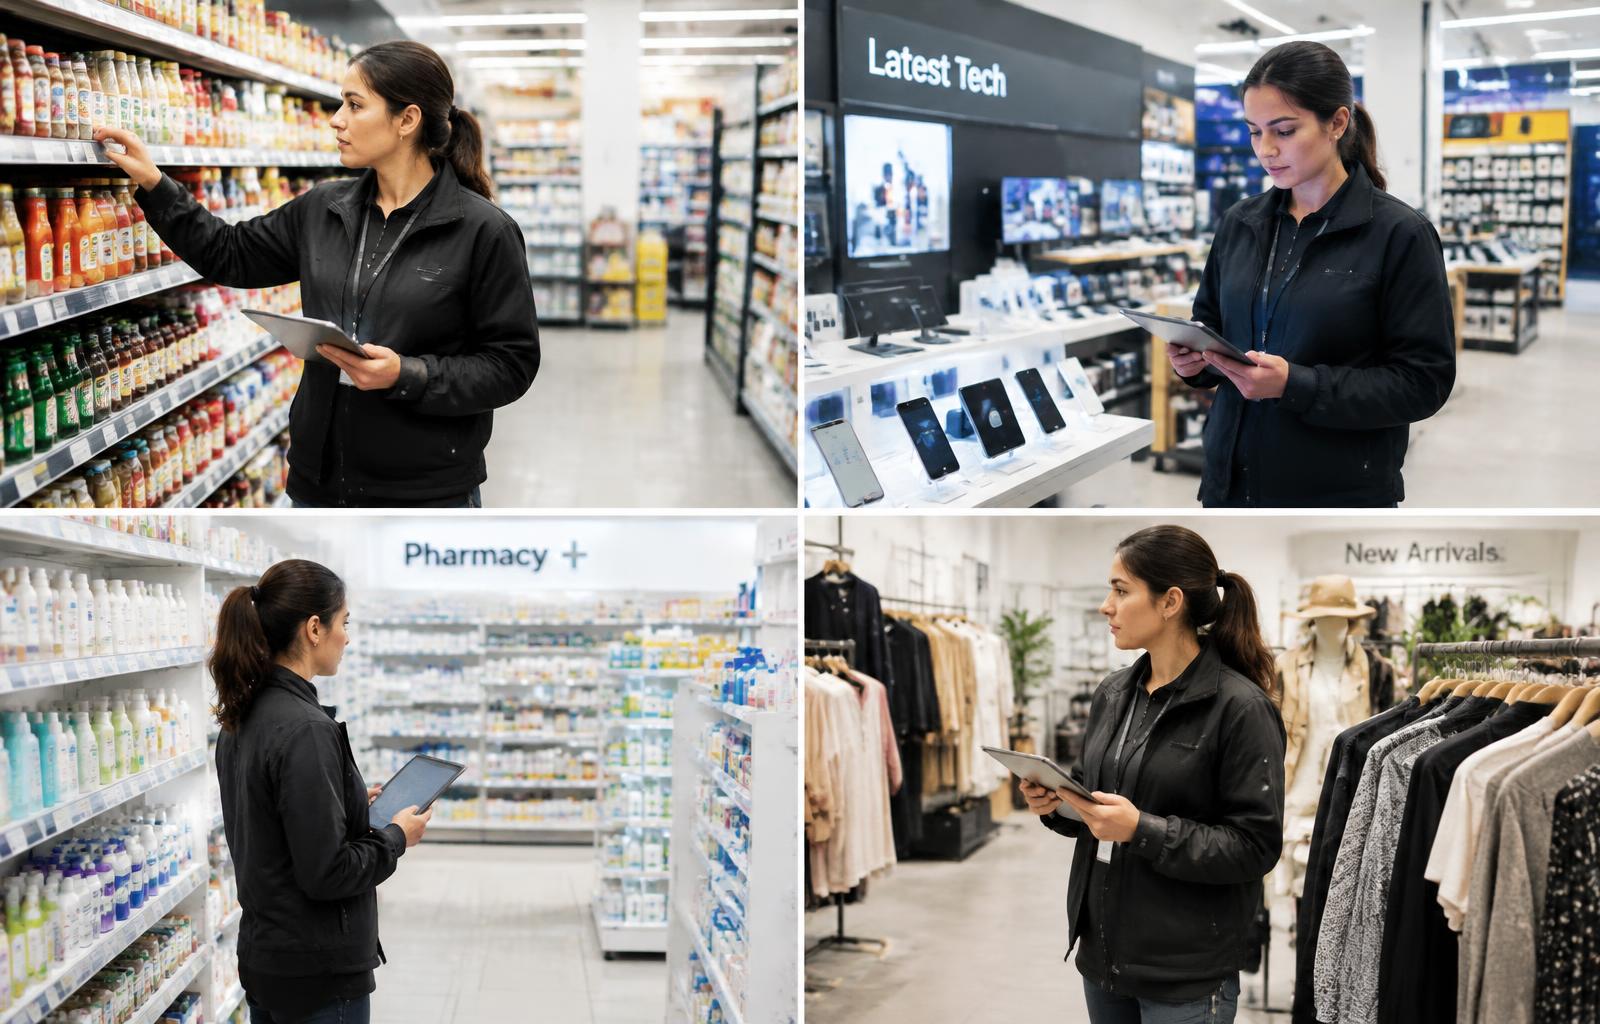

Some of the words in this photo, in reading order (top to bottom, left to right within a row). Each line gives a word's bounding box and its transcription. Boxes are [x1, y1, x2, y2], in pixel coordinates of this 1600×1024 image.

[868, 36, 951, 88] Latest
[954, 55, 1007, 98] Tech
[404, 541, 548, 573] Pharmacy
[1344, 541, 1398, 564] New
